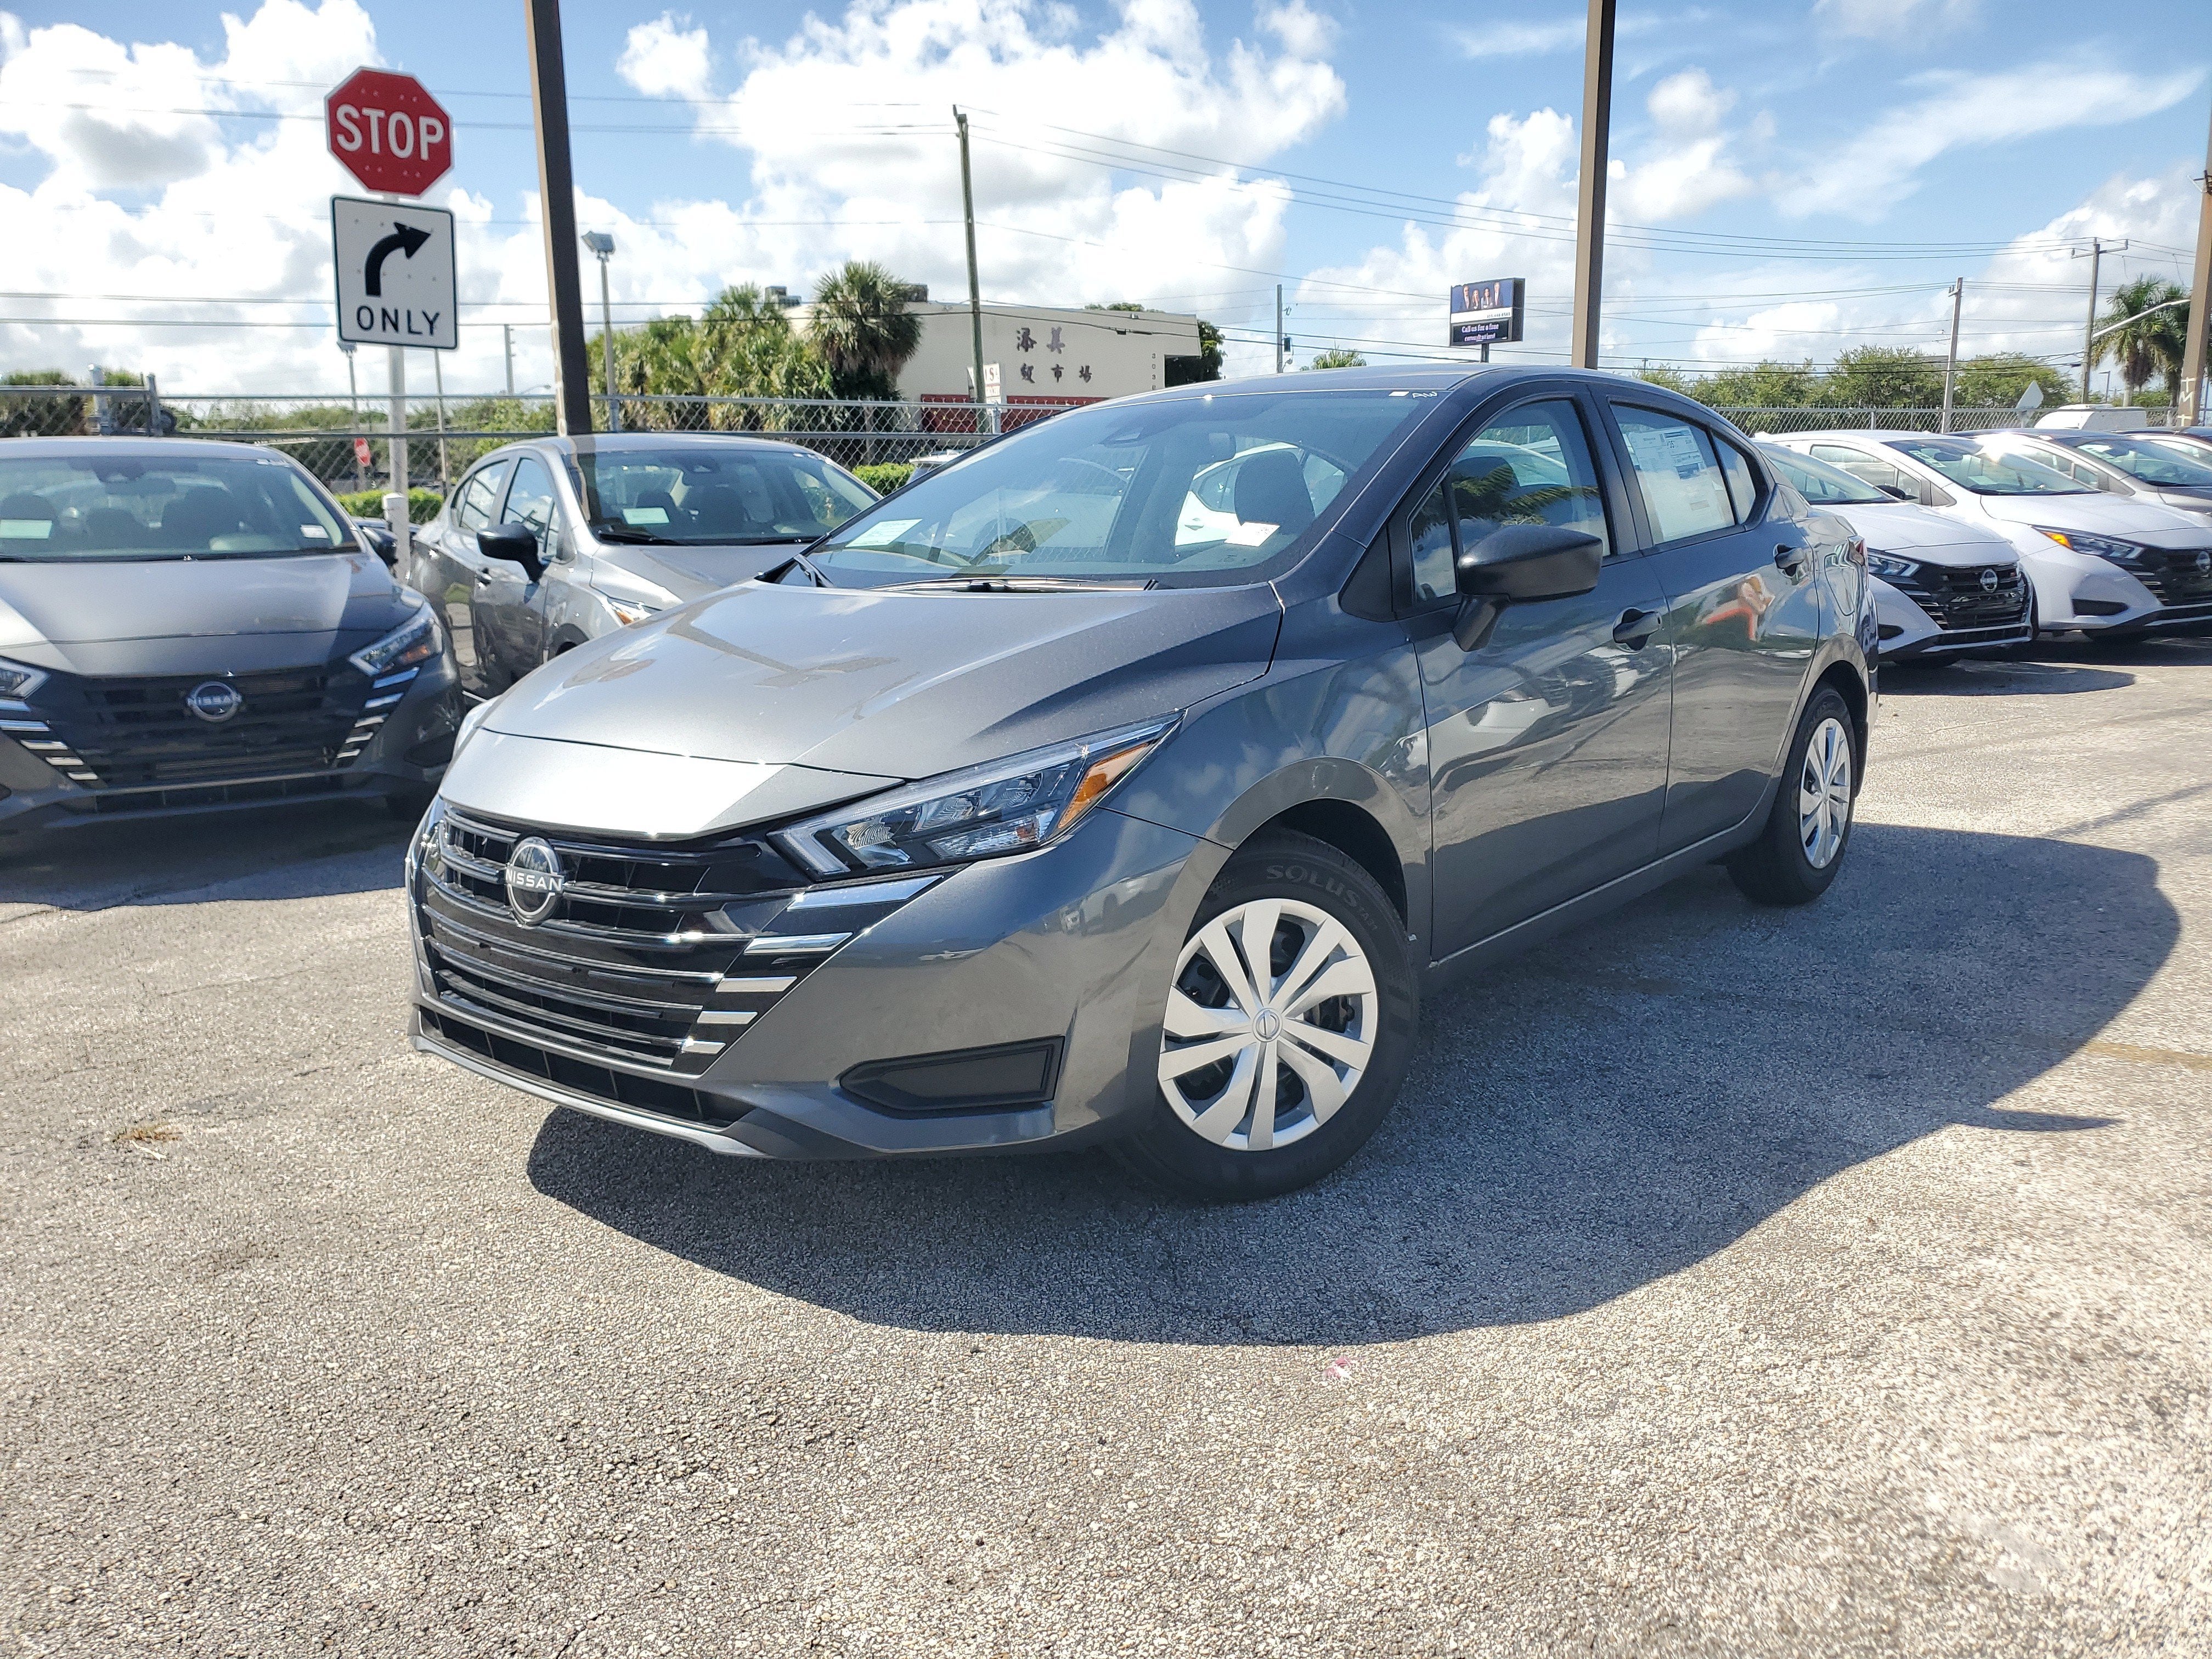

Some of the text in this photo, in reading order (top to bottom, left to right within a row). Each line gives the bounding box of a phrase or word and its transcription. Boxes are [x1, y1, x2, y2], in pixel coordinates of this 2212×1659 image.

[336, 104, 444, 161] STOP
[357, 306, 440, 336] ONLY
[187, 693, 242, 707] NISSAN
[506, 868, 562, 891] NISSAN
[1265, 865, 1360, 907] SOLUS
